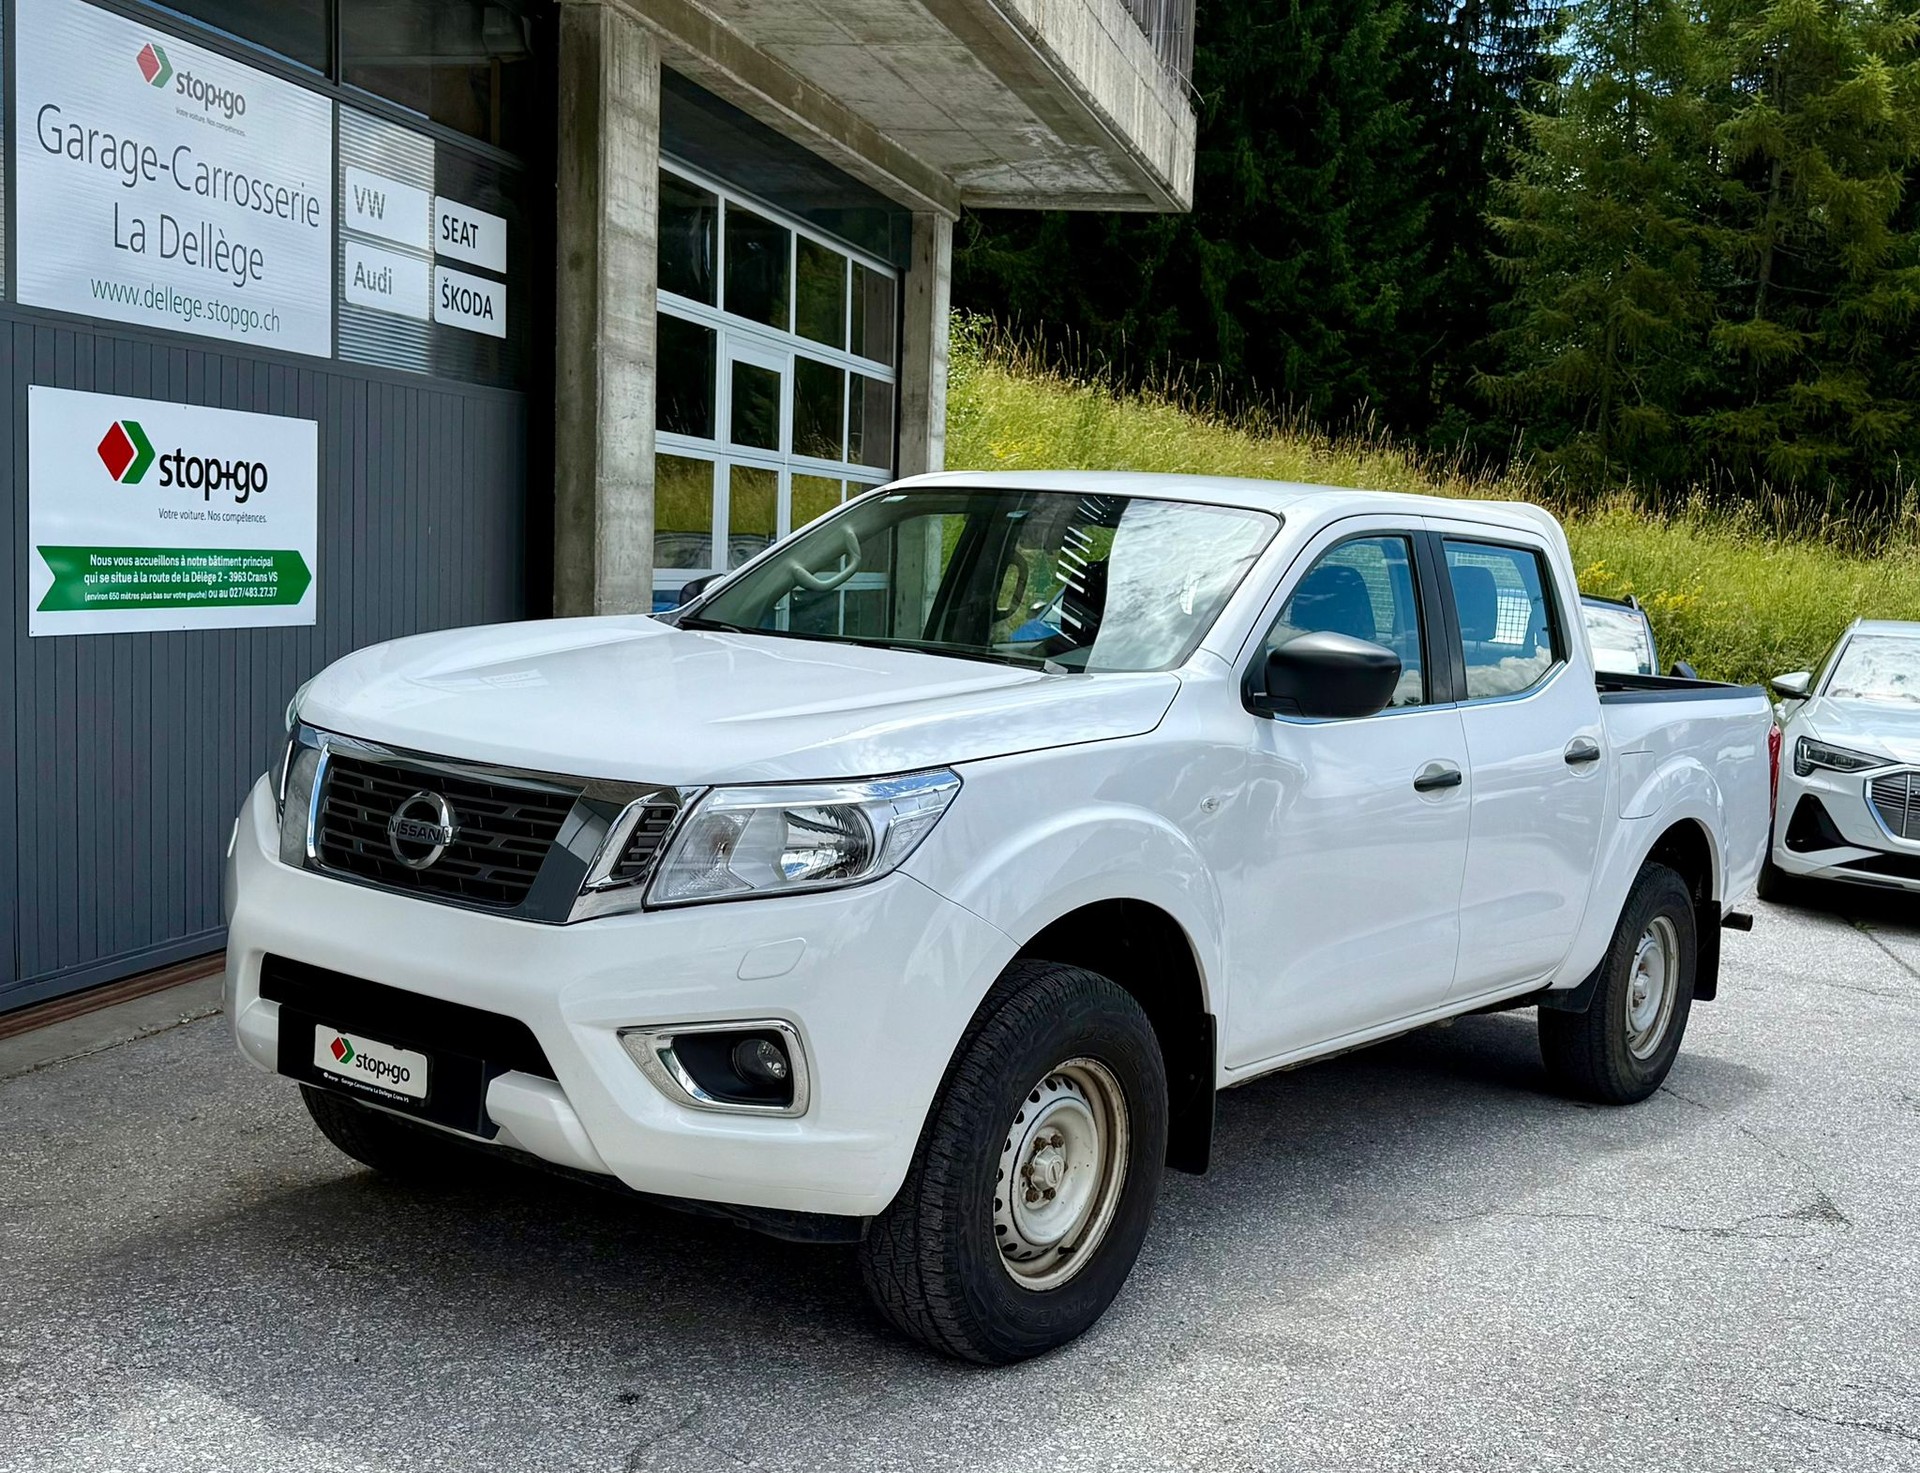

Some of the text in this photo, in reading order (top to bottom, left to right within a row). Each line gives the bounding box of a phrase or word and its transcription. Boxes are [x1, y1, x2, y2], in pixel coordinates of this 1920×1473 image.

[176, 70, 245, 119] stop+go
[37, 104, 320, 228] Garage-Carrosserie
[354, 184, 386, 220] VW
[114, 202, 264, 287] La Dellège
[442, 214, 479, 249] SEAT
[353, 261, 392, 295] Audi
[91, 278, 280, 333] www.dellege.stopgo.ch
[442, 277, 494, 321] ŠKODA
[159, 447, 268, 504] stop+go
[158, 508, 267, 525] Votre voiture. Nos compétences.
[84, 571, 98, 586] qui
[99, 573, 110, 583] se
[111, 571, 132, 583] situe
[133, 571, 139, 583] à
[140, 571, 148, 583] la
[149, 572, 170, 583] route
[171, 571, 181, 583] de
[182, 571, 190, 583] la
[217, 571, 223, 582] 2
[228, 571, 247, 582] 3963
[247, 571, 268, 582] Crans
[268, 571, 278, 582] VS
[90, 554, 274, 569] Nous vous accueillons à notre bâtiment principal
[109, 592, 120, 600] 650
[140, 591, 152, 602] plus
[152, 591, 163, 600] bas
[163, 592, 172, 600] sur
[172, 591, 186, 600] votre
[208, 589, 218, 598] ou
[218, 589, 228, 598] au
[229, 586, 278, 598] 027/483.27.37
[389, 817, 443, 844] NISSAN
[355, 1052, 411, 1084] stop+go
